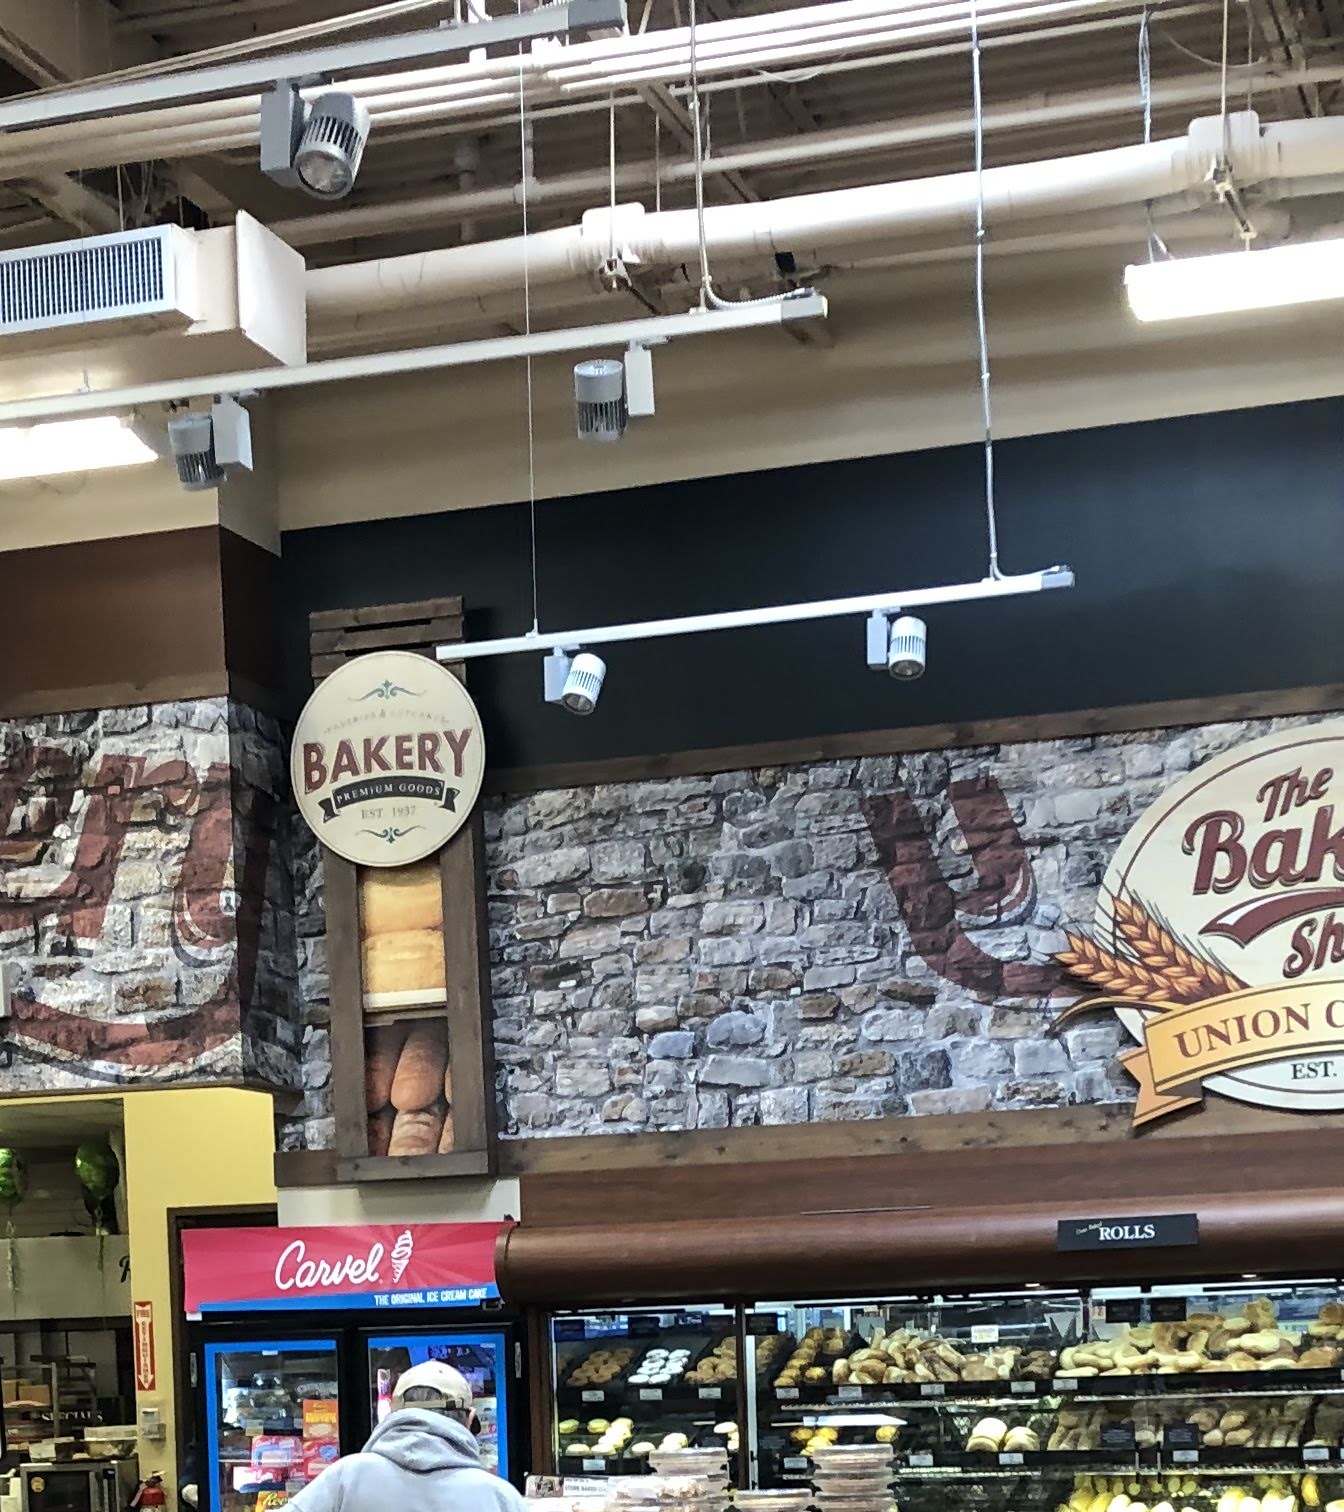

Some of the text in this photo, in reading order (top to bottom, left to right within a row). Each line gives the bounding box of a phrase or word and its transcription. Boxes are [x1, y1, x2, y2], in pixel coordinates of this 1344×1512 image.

[303, 728, 473, 795] BAKERY
[336, 781, 442, 804] PREMIUM GOODS
[1256, 766, 1334, 823] The
[392, 805, 417, 817] 1937
[1173, 1002, 1311, 1059] UNION
[1290, 1061, 1338, 1081] EST.
[1099, 1223, 1157, 1242] ROLLS
[274, 1239, 385, 1291] Carvel
[374, 1287, 488, 1307] THE ORIGINAL ICE CREAM CAKE
